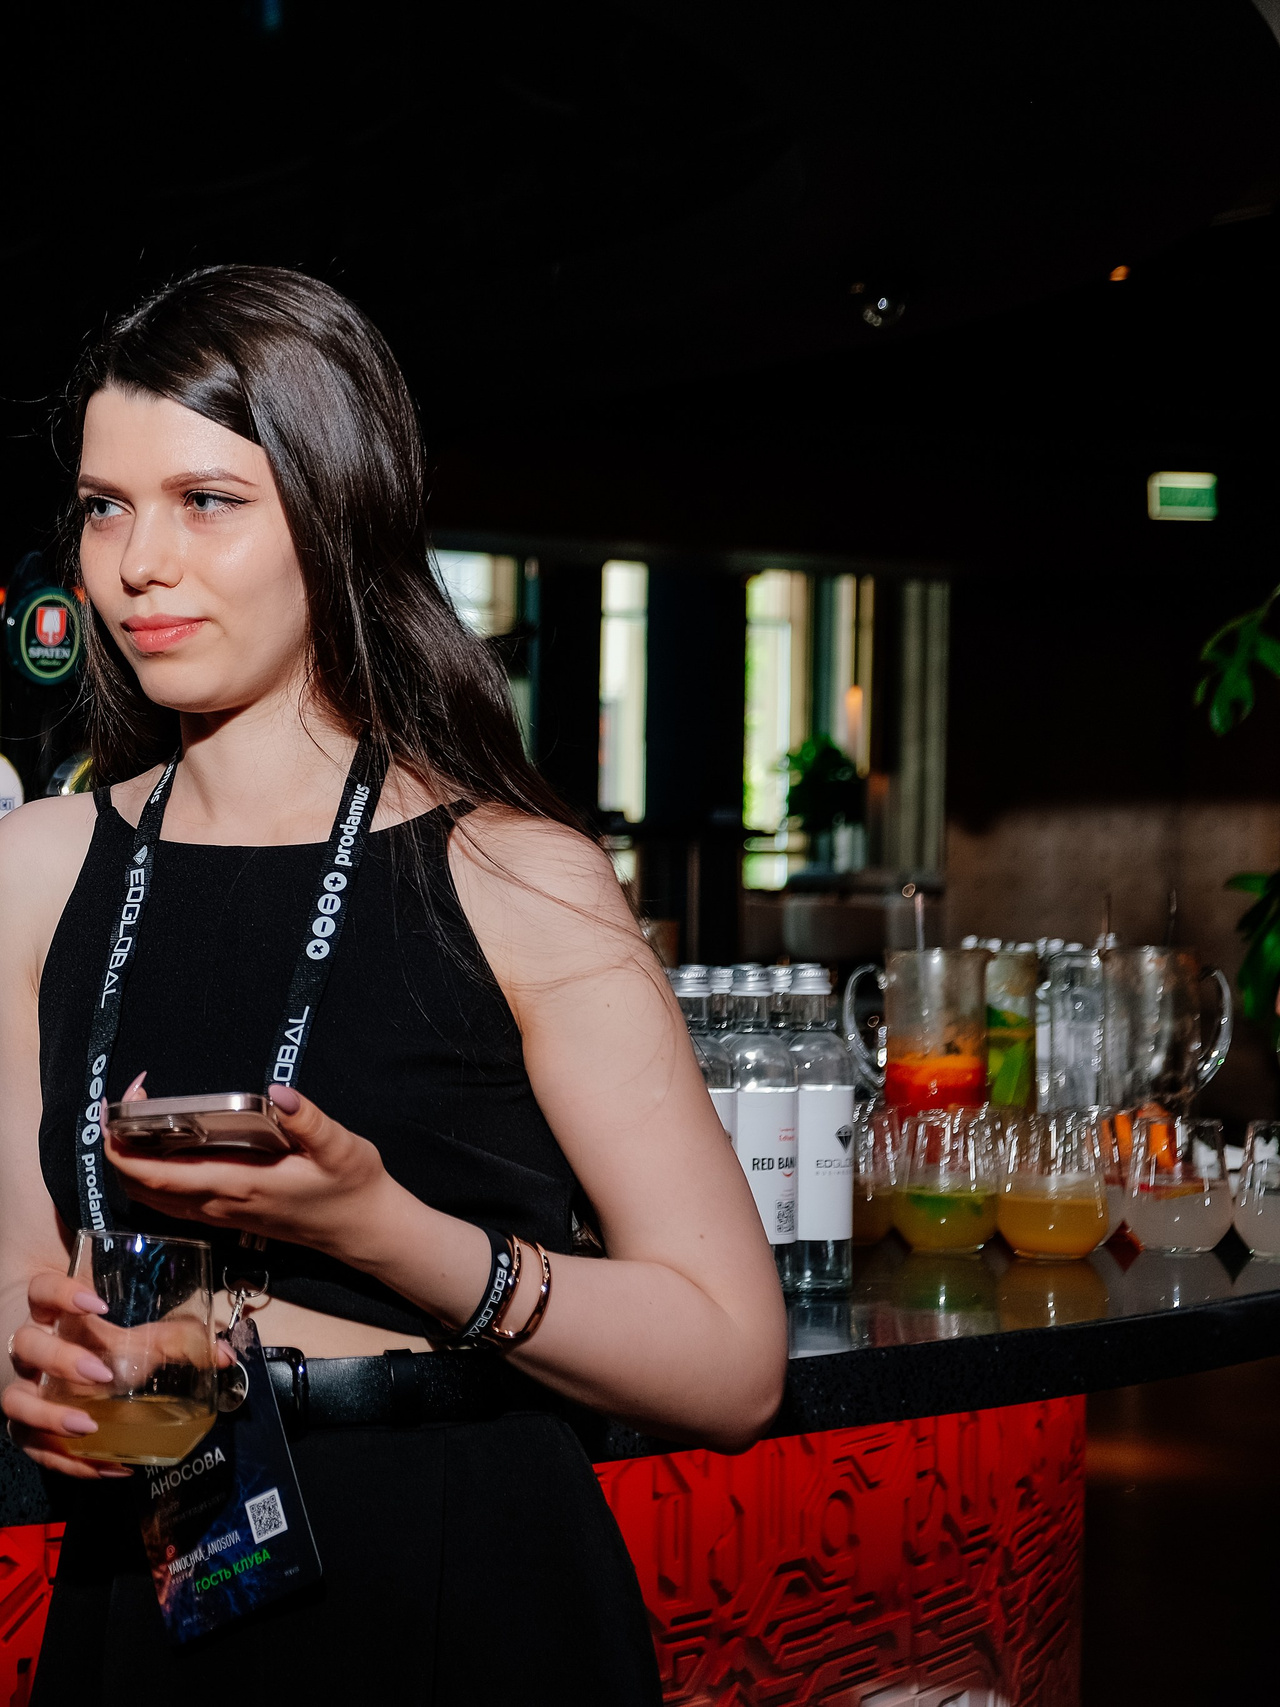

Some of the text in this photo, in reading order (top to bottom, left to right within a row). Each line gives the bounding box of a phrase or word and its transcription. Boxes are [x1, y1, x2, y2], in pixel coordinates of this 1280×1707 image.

[28, 647, 71, 659] SPATEN
[334, 783, 370, 867] prodamus
[100, 867, 145, 1009] EDGLOBAL
[752, 1156, 797, 1171] RED BAN
[81, 1152, 115, 1253] prodams
[462, 1266, 508, 1338] EDGLOBAL
[150, 1446, 226, 1500] АНОСОВА
[167, 1530, 241, 1576] YANOCHKA_ANOSOVA
[195, 1570, 232, 1594] ГОСТЬ
[233, 1548, 271, 1576] КЛУБА
